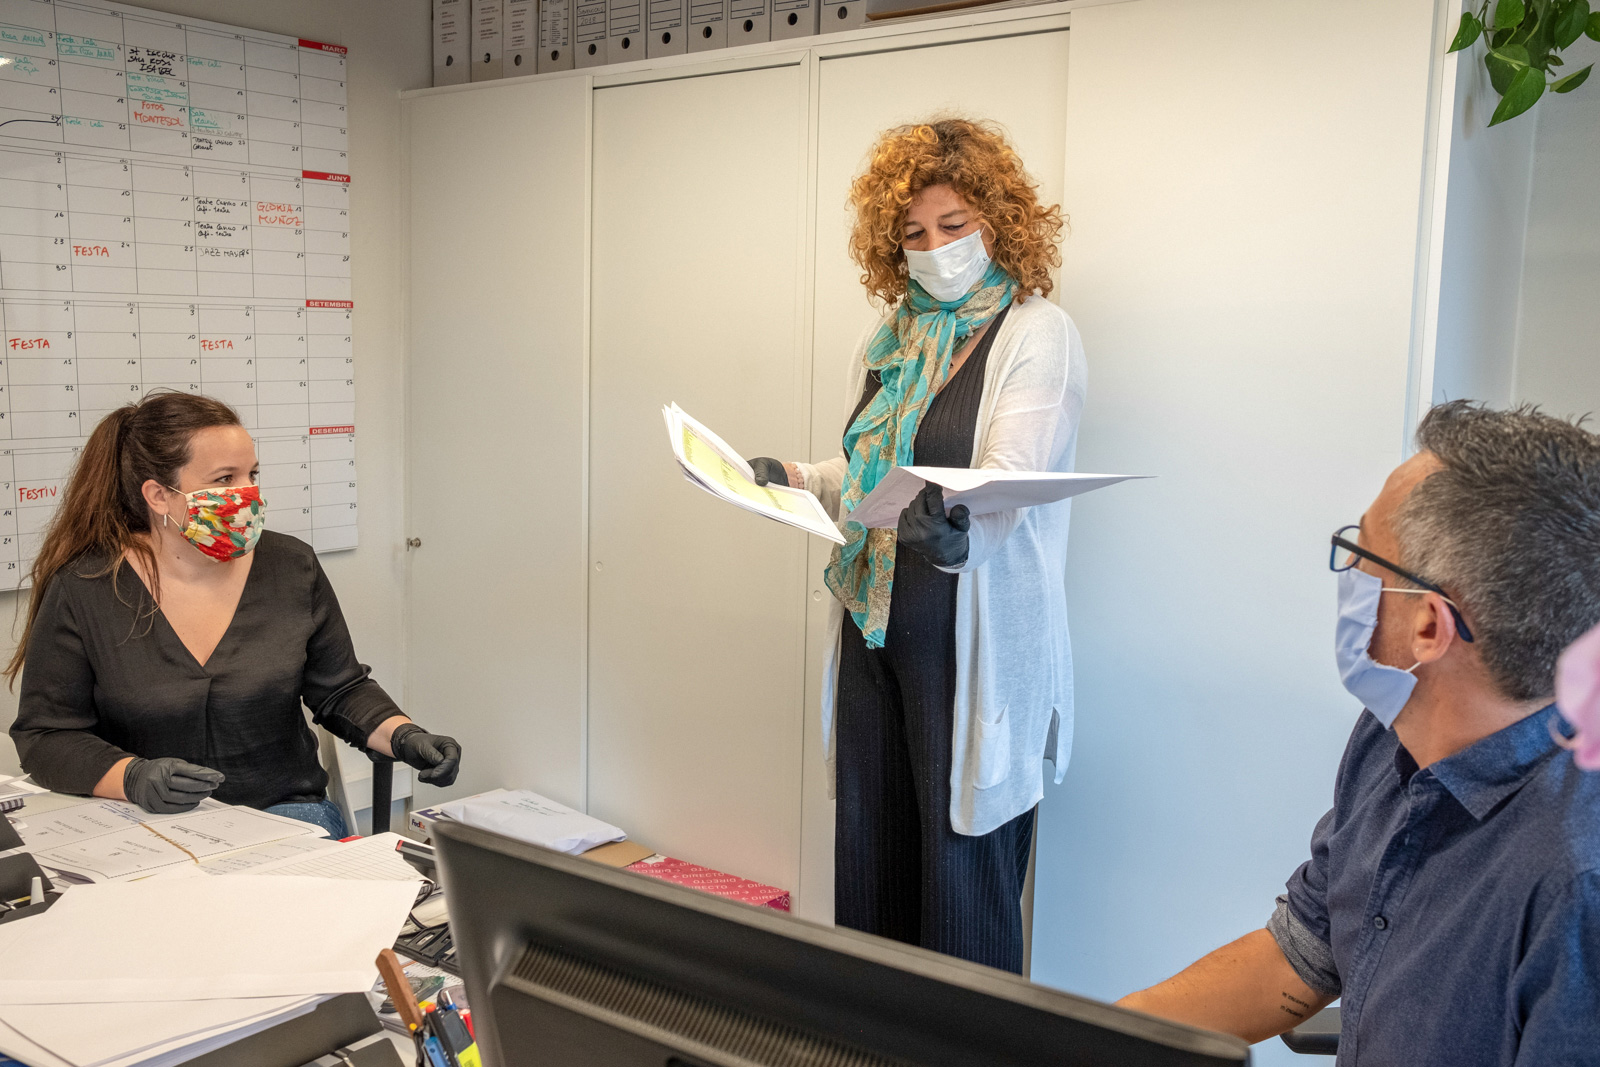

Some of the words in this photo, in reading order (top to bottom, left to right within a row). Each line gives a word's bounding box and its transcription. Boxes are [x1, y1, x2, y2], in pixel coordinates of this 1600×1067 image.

[142, 100, 165, 111] FOTOS
[256, 202, 294, 213] GLORIA
[72, 246, 110, 258] FESTA
[8, 338, 50, 350] FESTA
[200, 340, 234, 351] FESTA
[312, 426, 354, 434] DESEMBRE
[412, 818, 426, 830] FedEx
